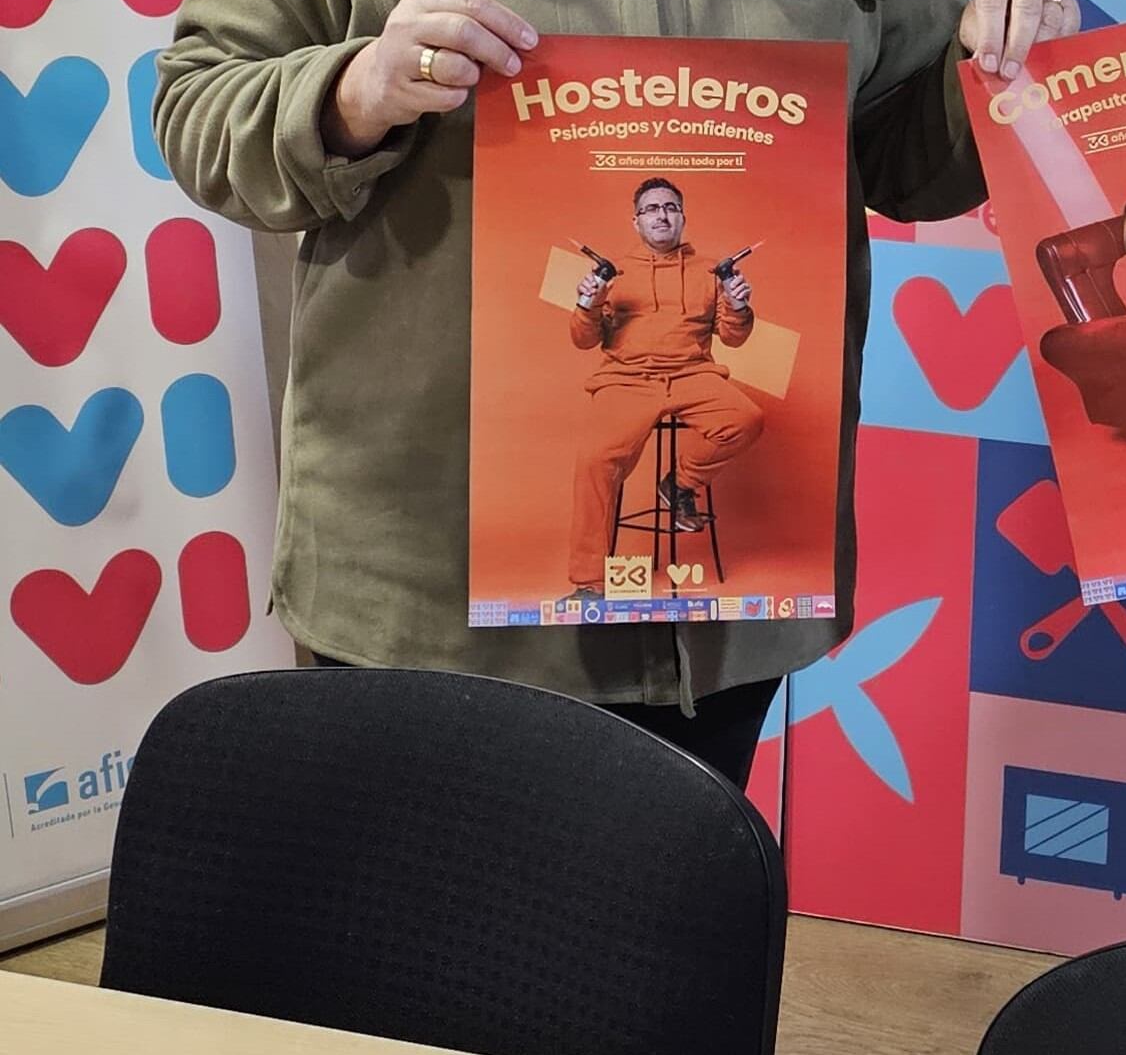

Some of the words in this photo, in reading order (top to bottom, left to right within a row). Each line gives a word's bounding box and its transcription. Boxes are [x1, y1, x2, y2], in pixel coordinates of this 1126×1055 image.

[511, 67, 808, 125] Hosteleros
[550, 119, 650, 143] Psicólogos
[651, 119, 665, 138] y
[667, 118, 774, 146] Confidentes
[618, 156, 645, 166] años
[646, 155, 690, 166] dándolo
[691, 156, 716, 166] todo
[717, 158, 734, 167] por
[735, 156, 743, 166] ti
[31, 814, 75, 832] Acreditado
